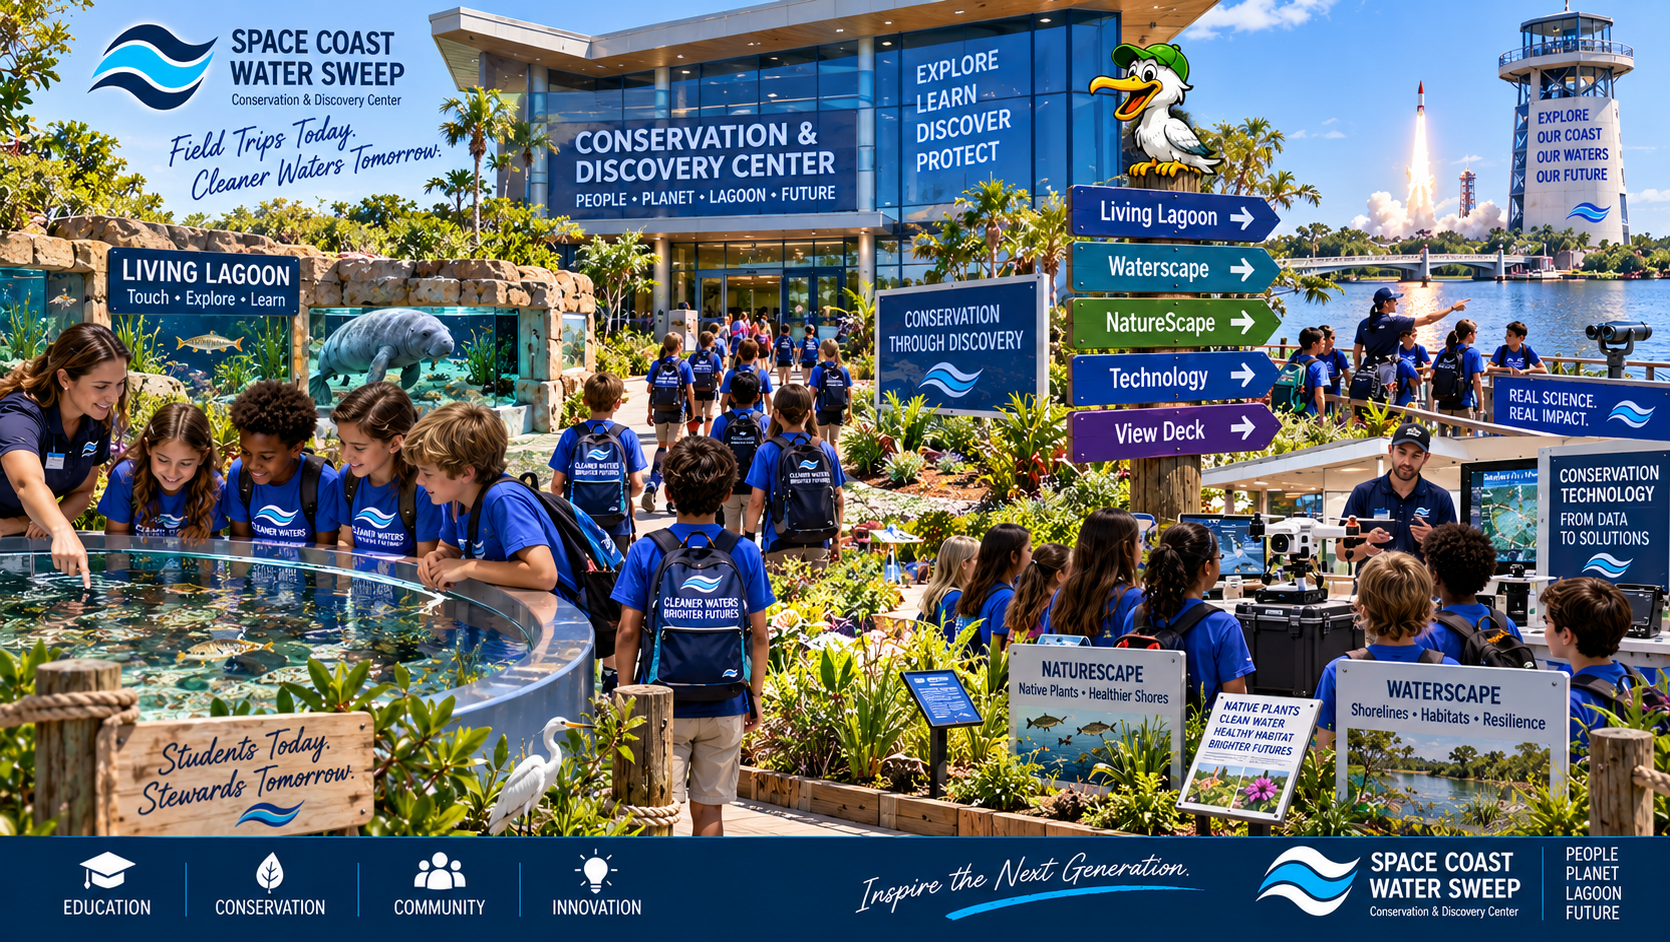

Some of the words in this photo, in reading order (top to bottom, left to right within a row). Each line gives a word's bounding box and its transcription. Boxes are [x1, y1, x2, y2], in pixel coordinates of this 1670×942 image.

[916, 49, 999, 85] EXPLORE
[916, 83, 977, 114] LEARN
[916, 109, 1011, 144] DISCOVER
[1538, 109, 1589, 124] EXPLORE
[574, 121, 788, 155] CONSERVATION
[797, 120, 818, 145] &
[1537, 131, 1561, 143] OUR
[1565, 128, 1602, 141] COAST
[916, 140, 1000, 173] PROTECT
[1537, 150, 1560, 163] OUR
[1564, 148, 1609, 162] WATERS
[574, 152, 723, 184] DISCOVERY
[731, 150, 836, 179] CENTER
[1536, 170, 1560, 183] OUR
[1564, 168, 1608, 182] FUTURE
[576, 192, 627, 208] PEOPLE
[642, 190, 694, 206] PLANET
[710, 187, 766, 204] LAGOON
[782, 184, 836, 202] FUTURE
[1101, 200, 1152, 228] Living
[1158, 203, 1218, 232] Lagoon
[122, 258, 198, 283] LIVING
[206, 262, 290, 286] LAGOON
[1108, 256, 1209, 283] Waterscape
[127, 289, 169, 304] Touch
[186, 290, 235, 308] Explore
[251, 292, 286, 307] Learn
[904, 304, 1000, 328] CONSERVATION
[1106, 312, 1216, 340] NatureScape
[889, 333, 945, 352] THROUGH
[949, 330, 1024, 352] DISCOVERY
[1110, 367, 1208, 391] Technology
[1510, 389, 1538, 407] REAL
[1543, 390, 1597, 409] SCIENCE.
[1510, 406, 1538, 423] REAL
[1542, 408, 1589, 427] IMPACT.
[1115, 422, 1157, 445] View
[1163, 419, 1205, 442] Deck
[1560, 465, 1659, 483] CONSERVATION
[1560, 486, 1655, 503] TECHNOLOGY
[1560, 512, 1594, 526] FROM
[1598, 512, 1628, 526] DATA
[278, 528, 306, 537] WATERS
[1560, 531, 1575, 545] TO
[1579, 531, 1649, 546] SOLUTIONS
[664, 597, 703, 608] CLEANER
[705, 598, 738, 608] WATERS
[664, 609, 703, 619] BRIGHTER
[705, 609, 739, 619] FUTURES
[1042, 661, 1144, 683] NATURESCAPE
[1019, 682, 1048, 697] Native
[1050, 685, 1079, 698] Plants
[1089, 686, 1132, 702] Healthier
[1134, 689, 1169, 704] Shores
[1387, 680, 1501, 705] WATERSCAPE
[1224, 701, 1260, 712] NATIVE
[1261, 703, 1300, 716] PLANTS
[1351, 702, 1408, 721] Shorelines
[1421, 707, 1470, 725] Habitats
[1483, 711, 1546, 731] Resilience
[1219, 714, 1250, 725] CLEAN
[1252, 717, 1286, 728] WATER
[1213, 727, 1254, 739] HEALTHY
[1255, 730, 1294, 742] HABITAT
[158, 736, 259, 776] Students
[266, 726, 330, 763] Today.
[1208, 739, 1251, 752] BRIGHTER
[1252, 743, 1293, 756] FUTURES
[138, 769, 247, 816] Stewards
[254, 764, 354, 797] Tomorrow.
